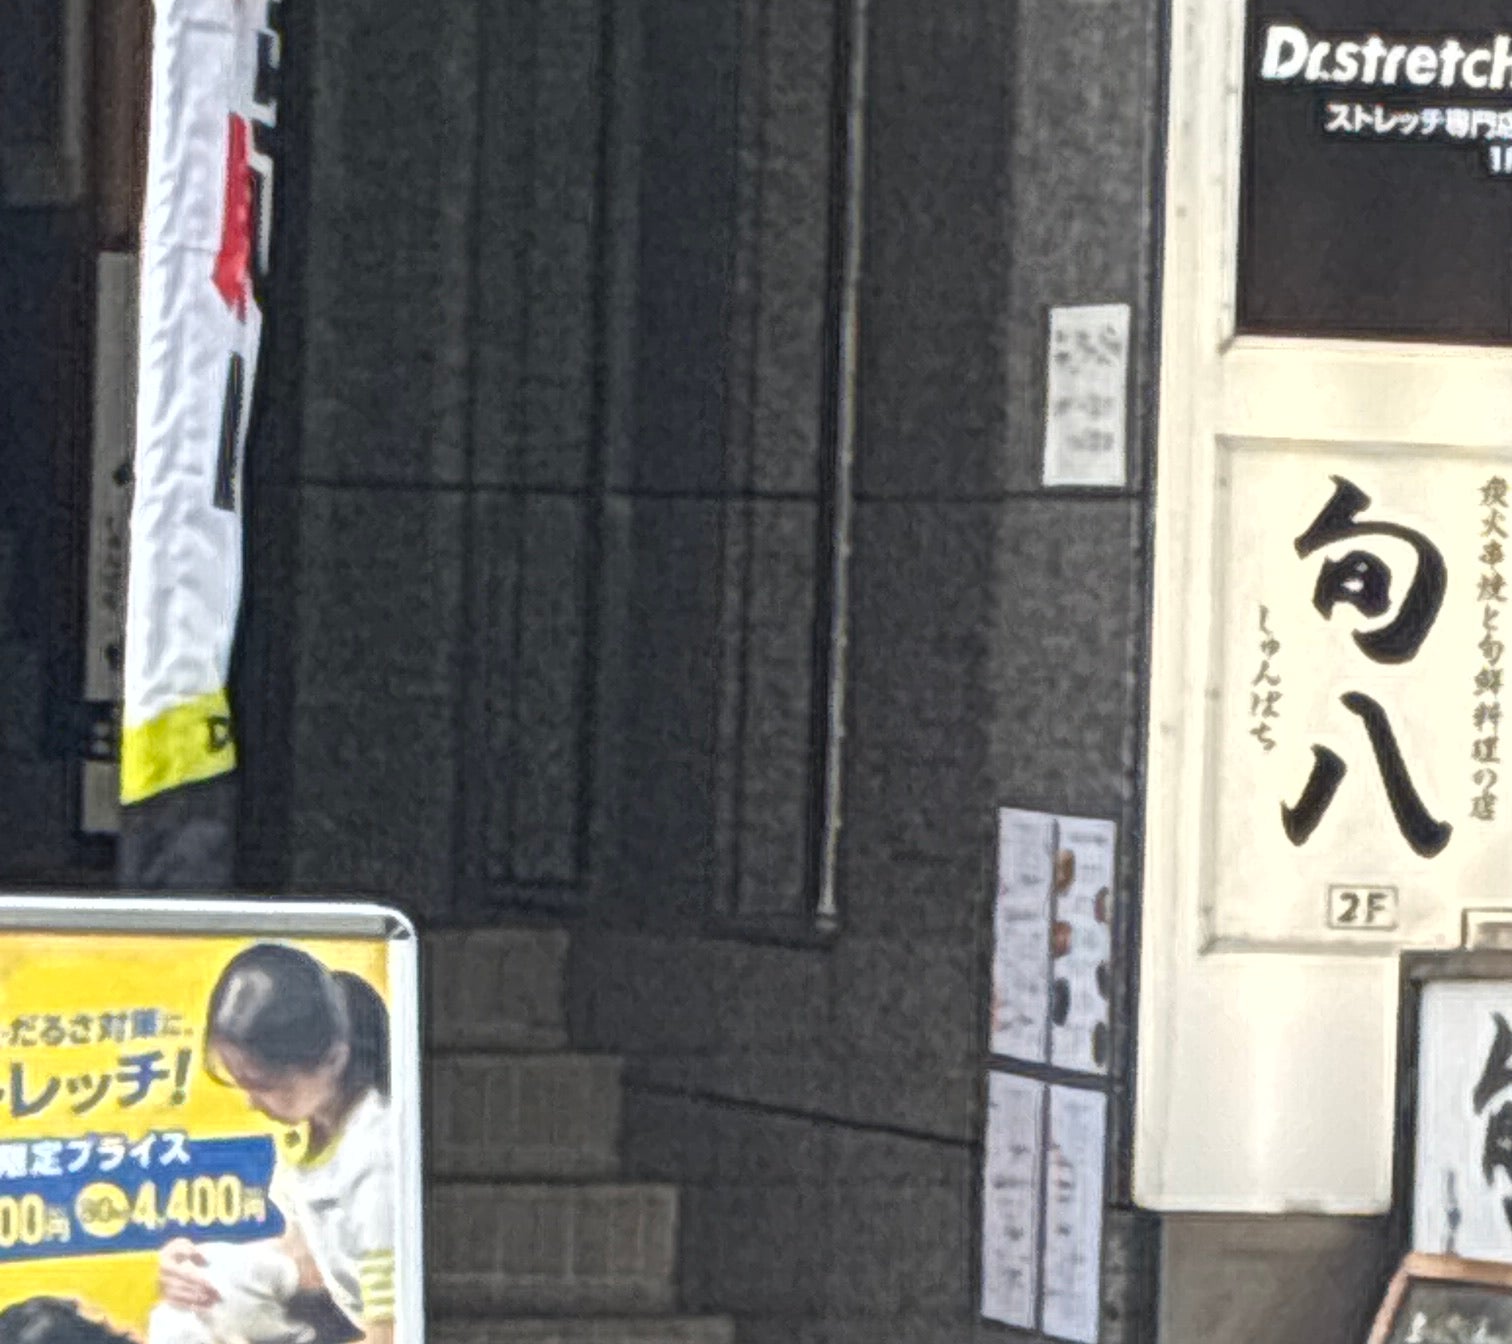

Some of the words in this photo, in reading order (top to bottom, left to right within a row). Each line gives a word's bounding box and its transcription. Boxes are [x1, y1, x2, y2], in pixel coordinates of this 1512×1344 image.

[1281, 474, 1454, 859] 旬八
[1339, 891, 1387, 924] 2F
[0, 1048, 192, 1117] レッチ!
